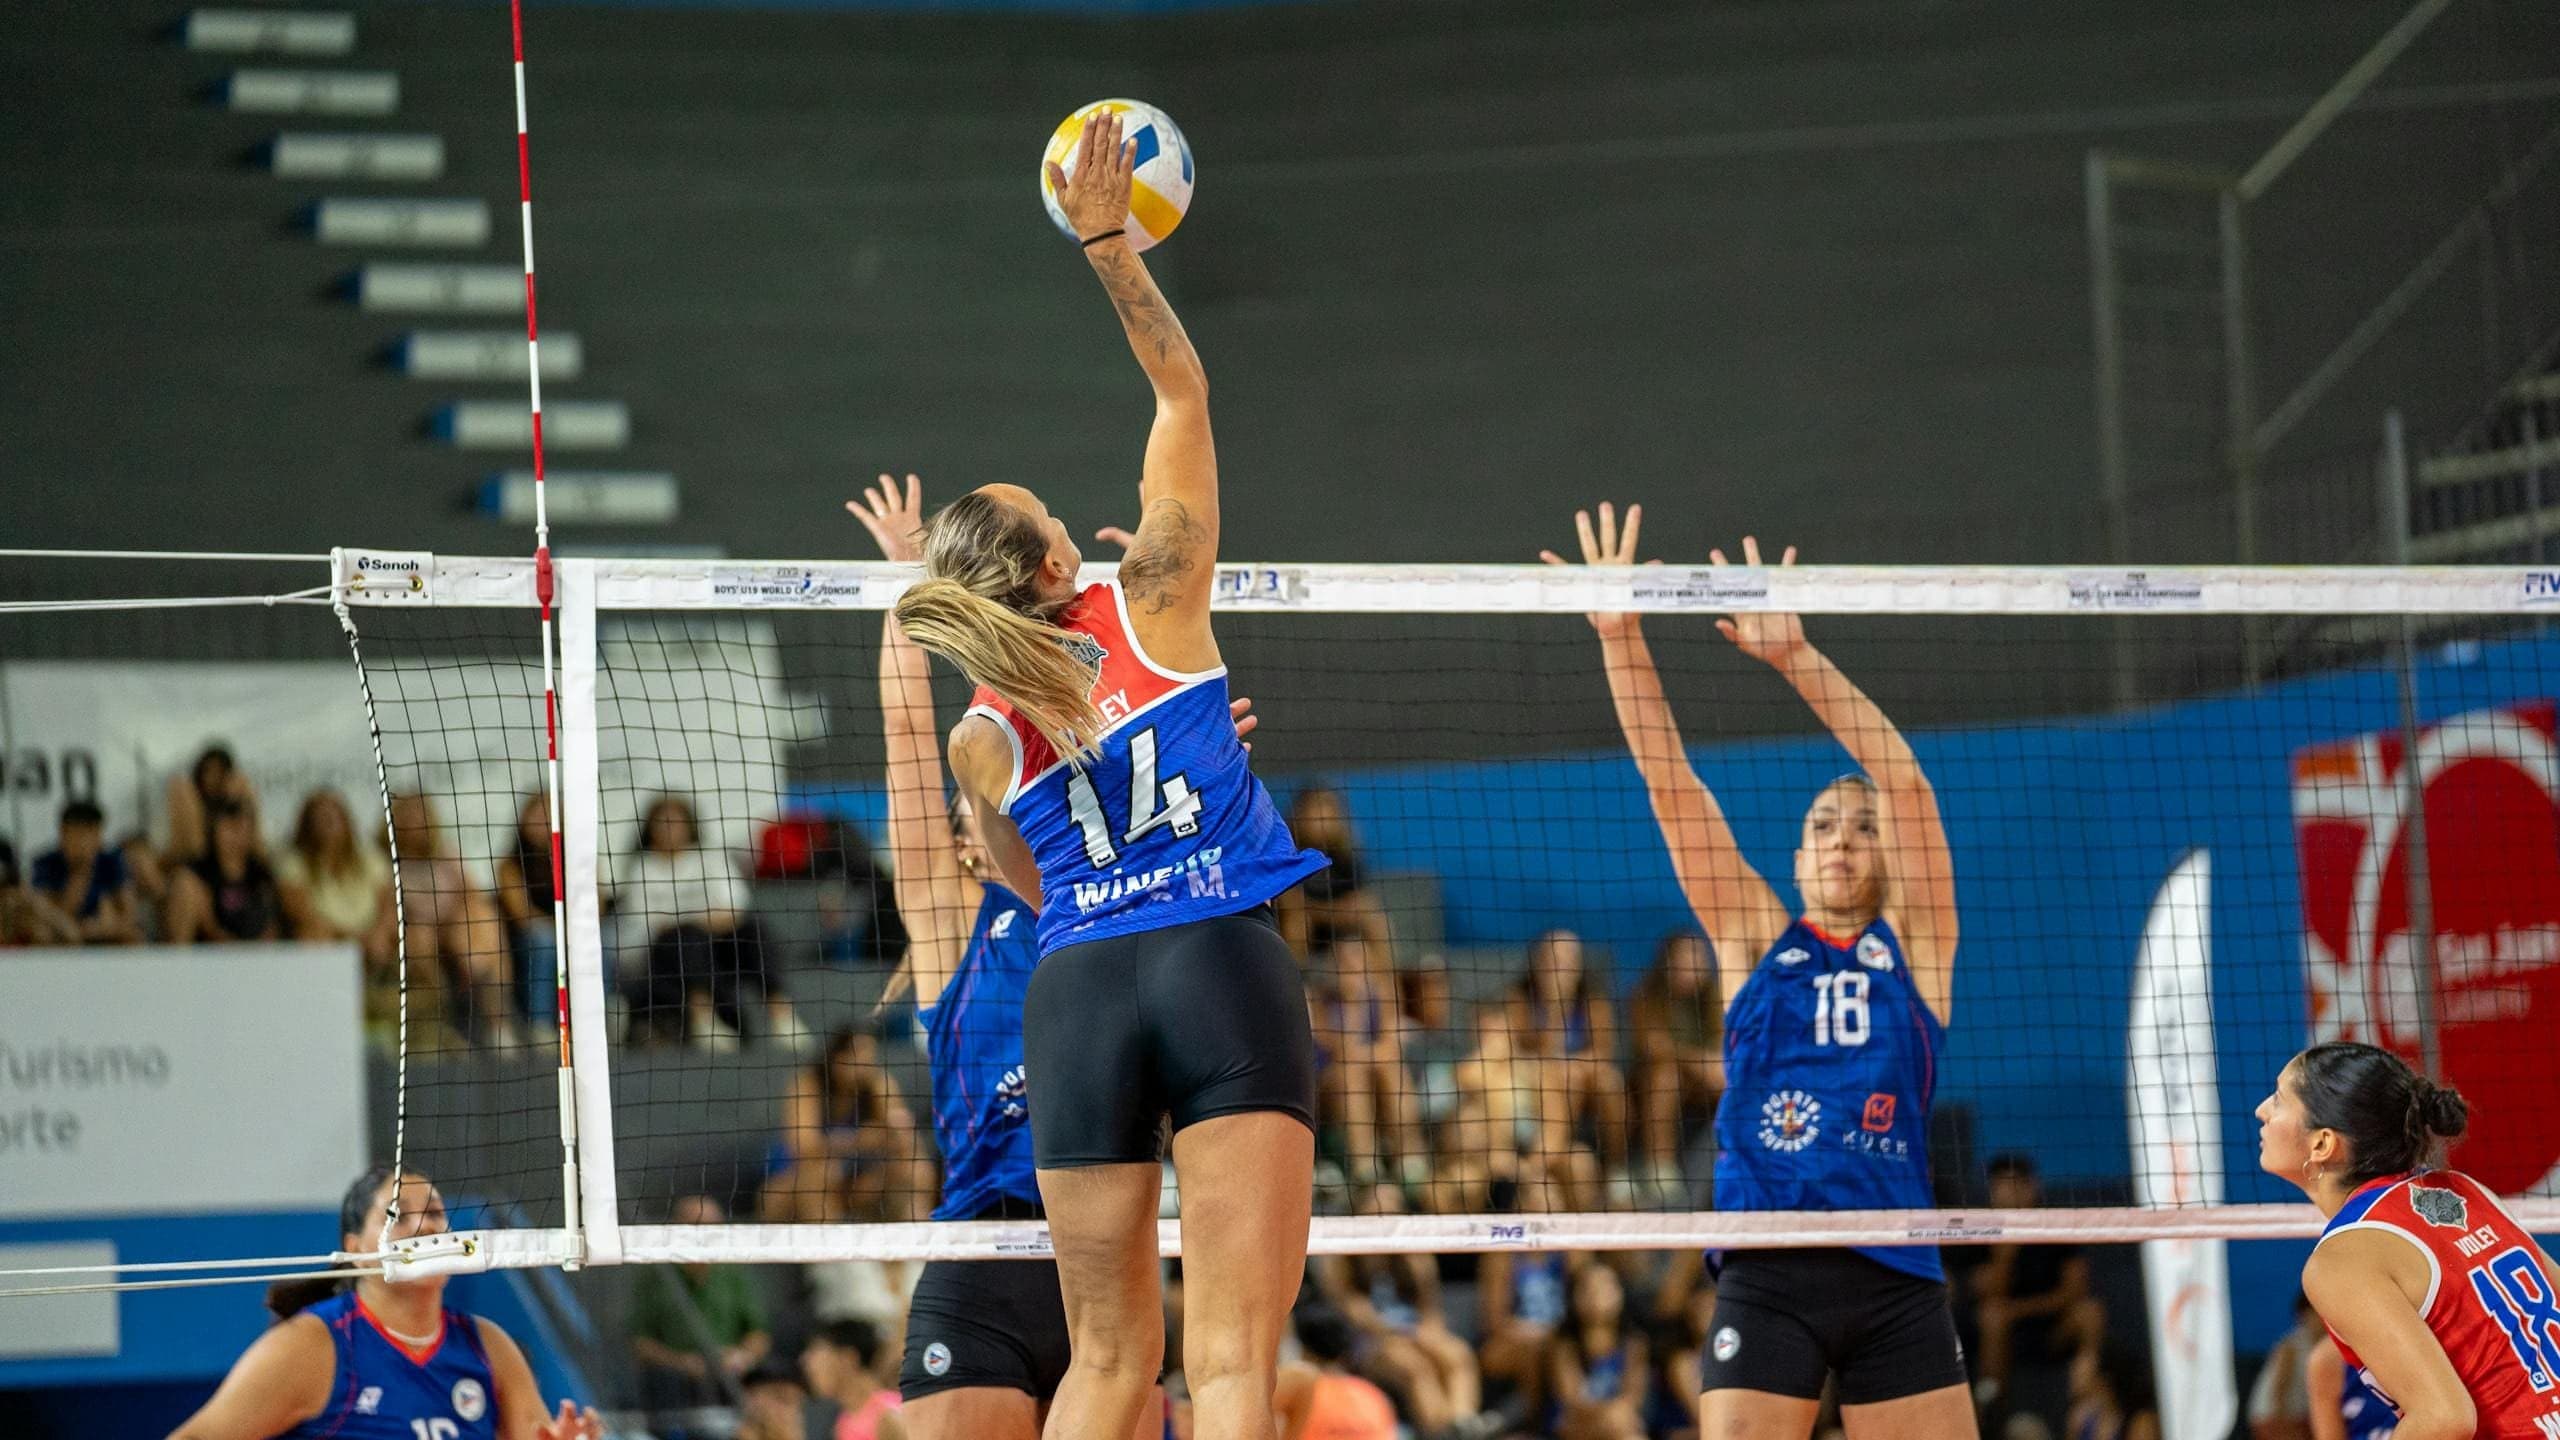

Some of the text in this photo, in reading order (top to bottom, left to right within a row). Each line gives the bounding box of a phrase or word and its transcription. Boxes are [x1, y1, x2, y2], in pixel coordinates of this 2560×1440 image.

[372, 559, 419, 571] Senoh
[1066, 724, 1202, 869] 14
[1813, 969, 1870, 1046] 18
[1491, 1226, 1524, 1238] FIVB
[2453, 1224, 2500, 1258] VOLEY
[2467, 1246, 2560, 1394] 18
